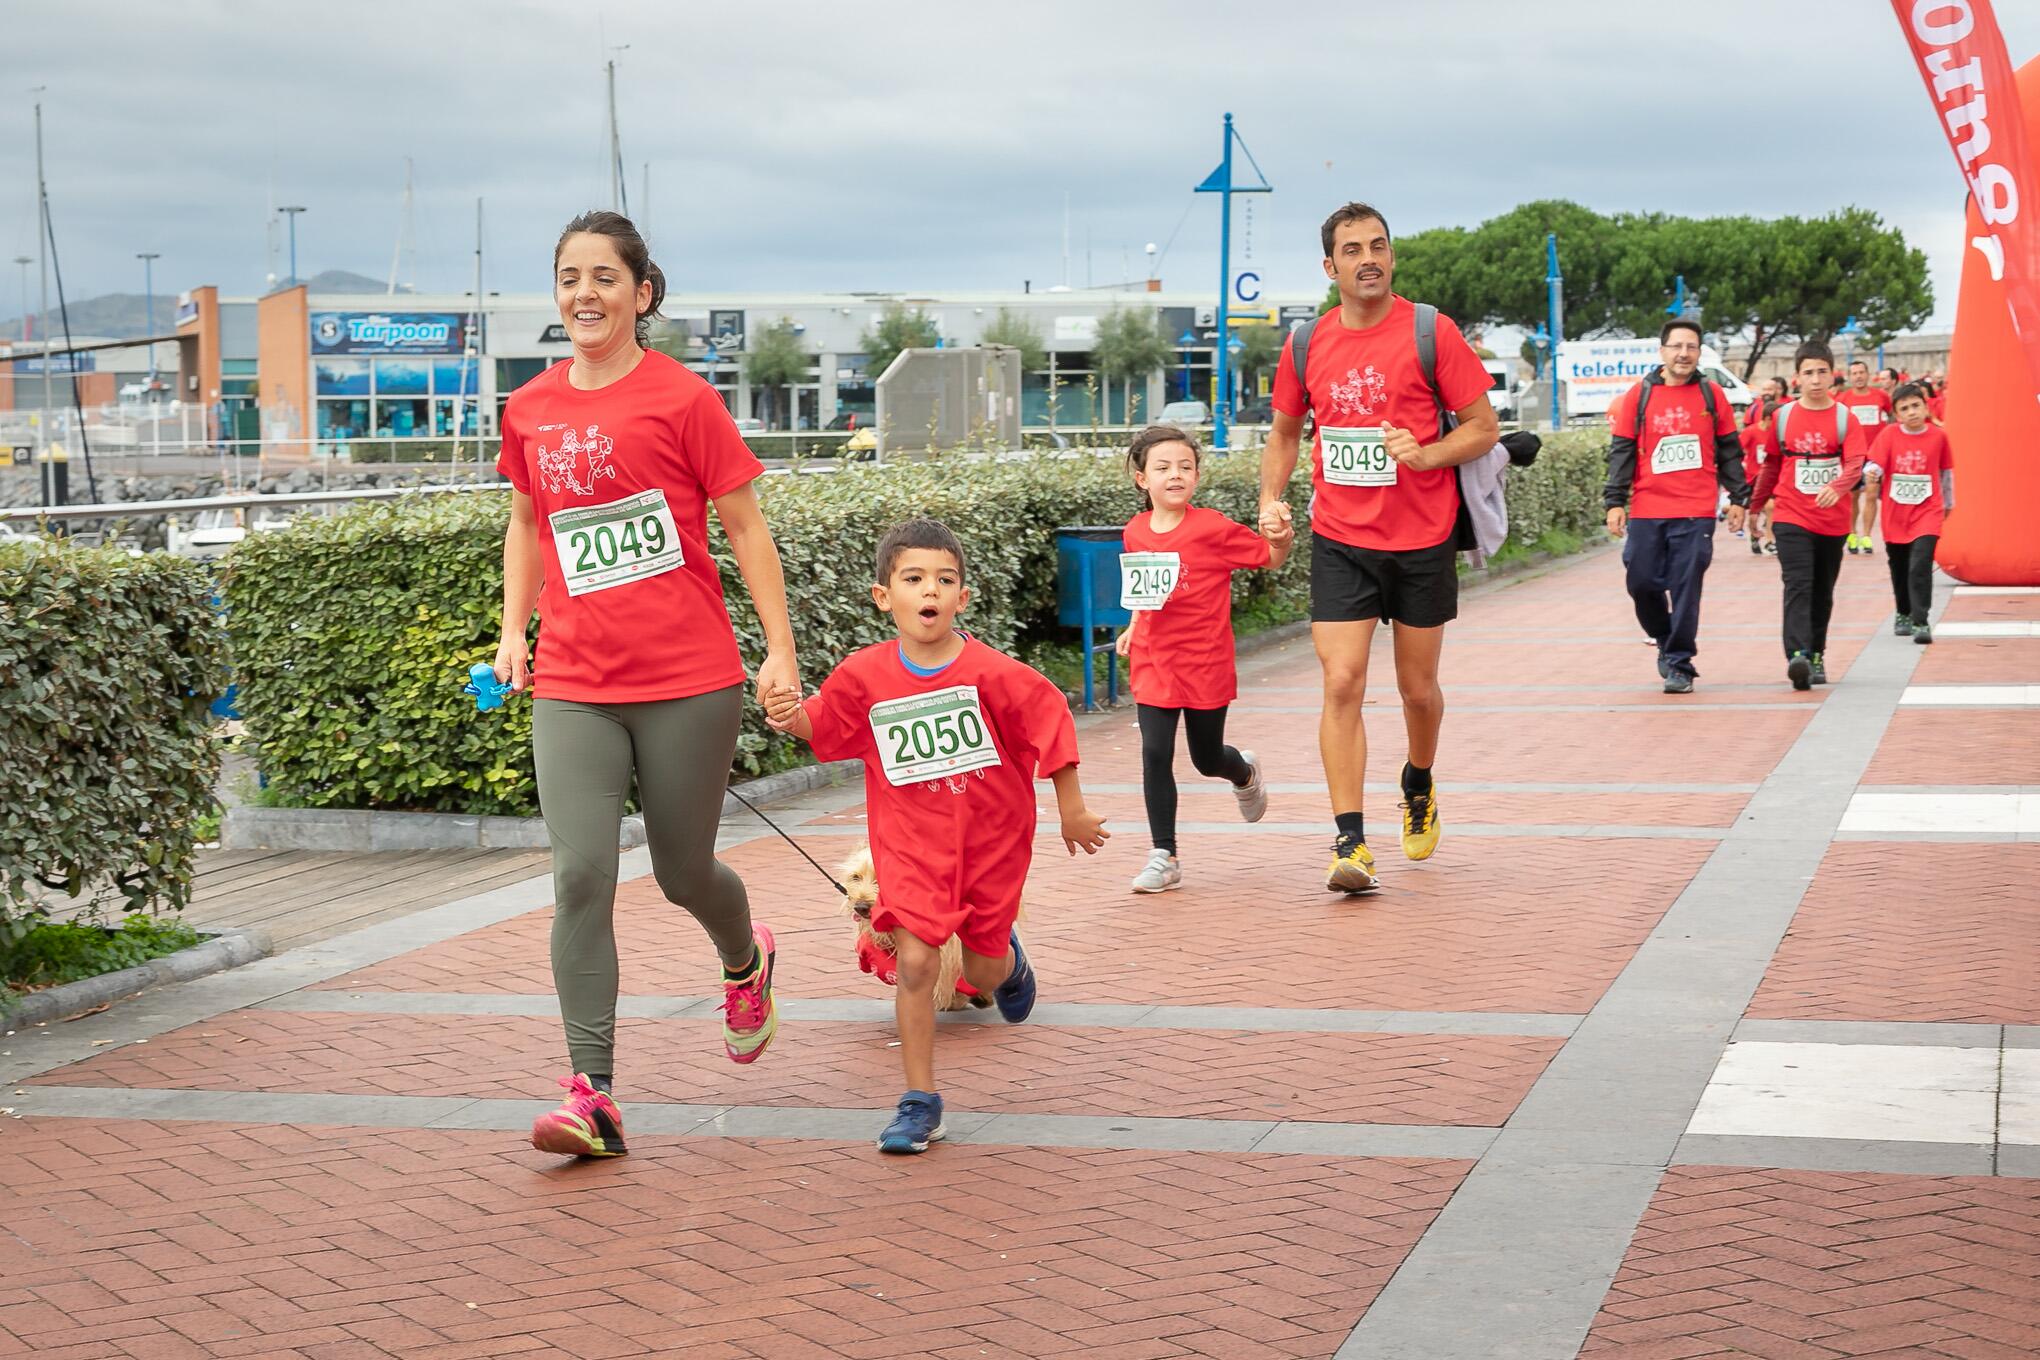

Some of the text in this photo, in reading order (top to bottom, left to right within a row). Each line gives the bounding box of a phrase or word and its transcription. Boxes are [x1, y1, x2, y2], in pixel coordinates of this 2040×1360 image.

[1235, 272, 1261, 302] C
[349, 319, 448, 346] Tarpoon
[1329, 443, 1387, 471] 2049
[1657, 443, 1696, 464] 2006
[1895, 482, 1928, 497] 2006
[570, 514, 666, 573] 2049
[888, 709, 983, 764] 2050
